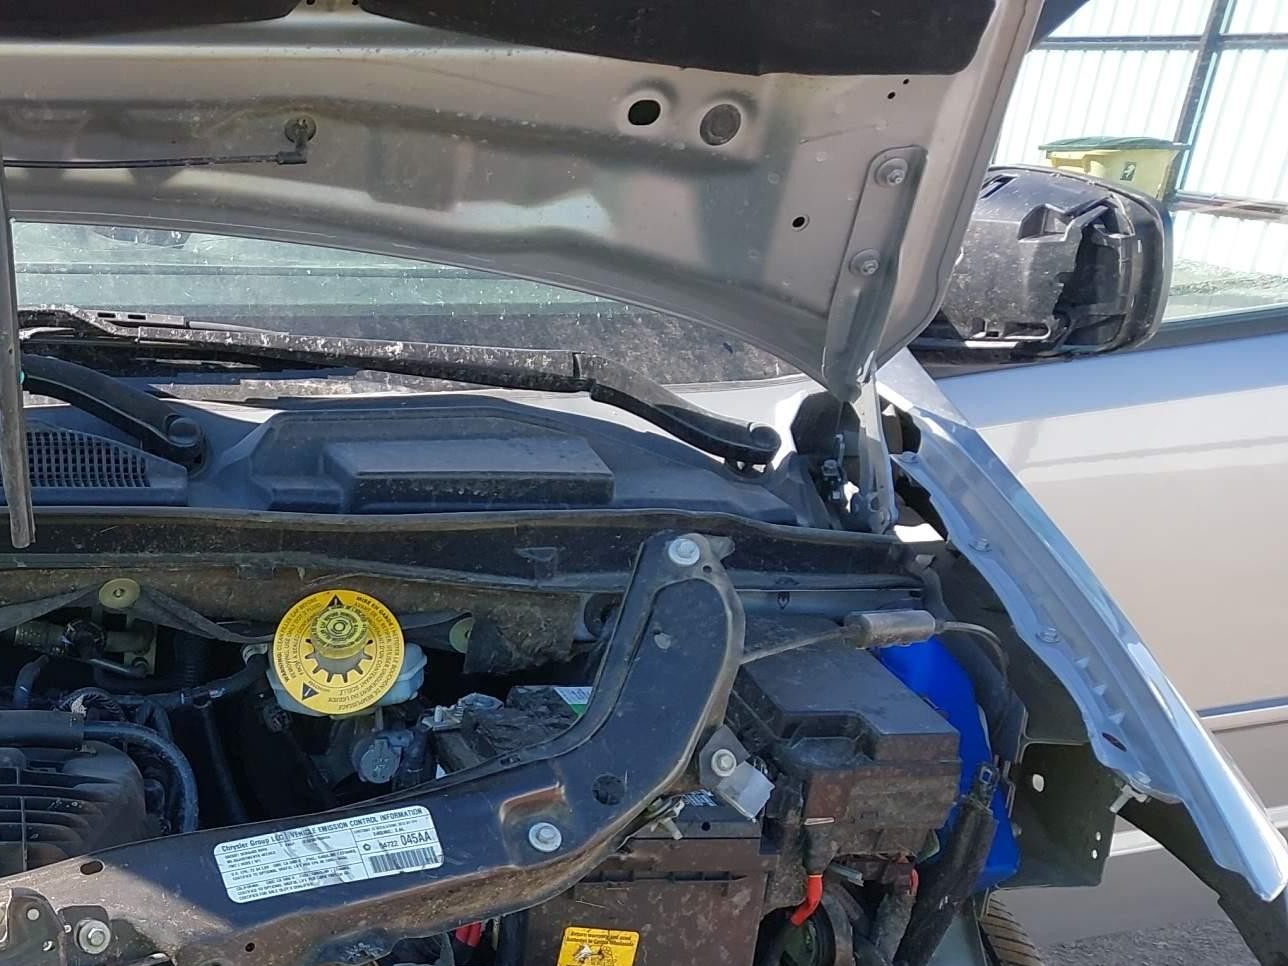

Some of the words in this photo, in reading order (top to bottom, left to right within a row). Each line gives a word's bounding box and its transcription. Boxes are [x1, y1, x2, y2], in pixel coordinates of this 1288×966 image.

[220, 840, 248, 852] Chrysler
[248, 836, 270, 847] Group
[317, 821, 348, 833] EMISSION
[348, 815, 378, 827] CONTROL
[378, 806, 423, 822] INFORMATION
[398, 829, 432, 846] 045AA
